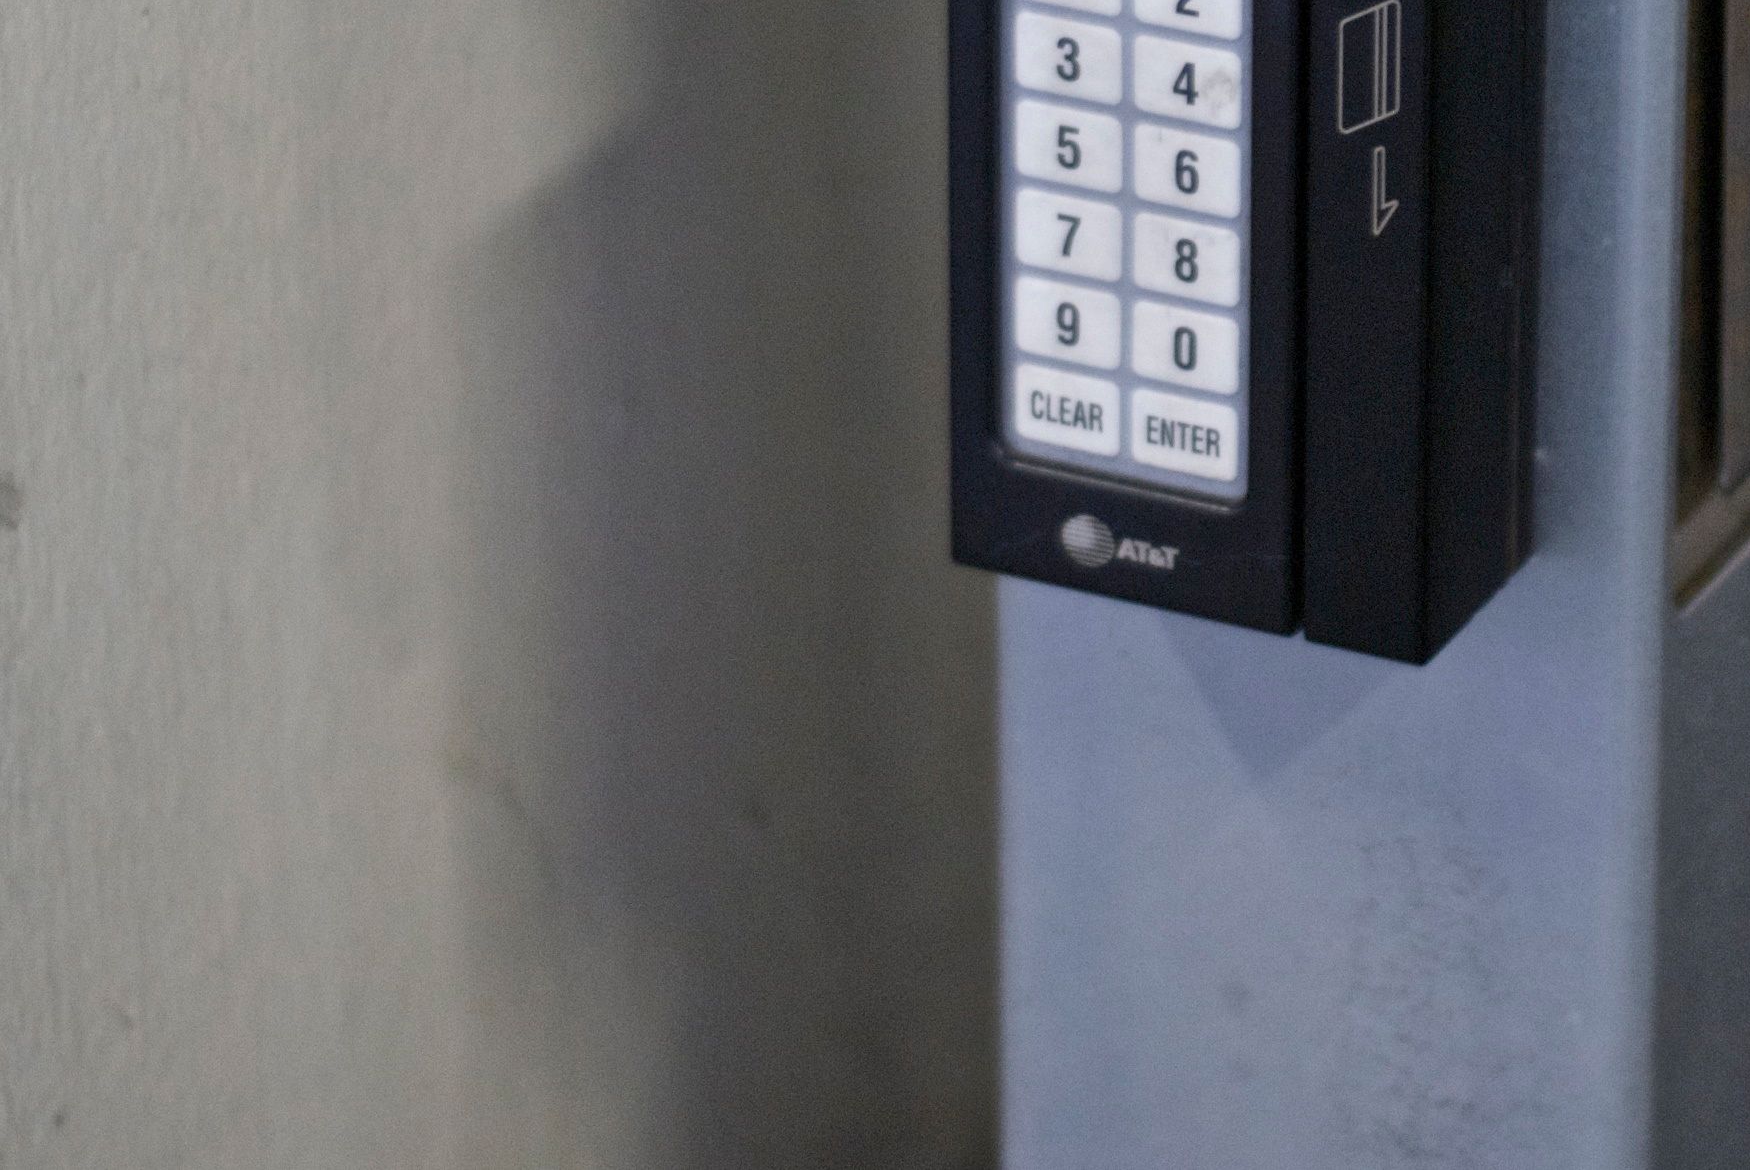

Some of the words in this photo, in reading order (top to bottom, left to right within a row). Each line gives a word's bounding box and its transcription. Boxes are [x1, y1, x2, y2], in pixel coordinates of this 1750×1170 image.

[1055, 36, 1081, 82] 3
[1172, 62, 1199, 106] 4
[1056, 124, 1082, 170] 5
[1174, 149, 1200, 195] 6
[1056, 212, 1082, 258] 7
[1174, 237, 1199, 284] 8
[1055, 301, 1081, 347] 9
[1172, 326, 1198, 372] 0
[1029, 389, 1105, 434] CLEAR
[1145, 414, 1222, 459] ENTER
[1116, 537, 1180, 571] AT&T
